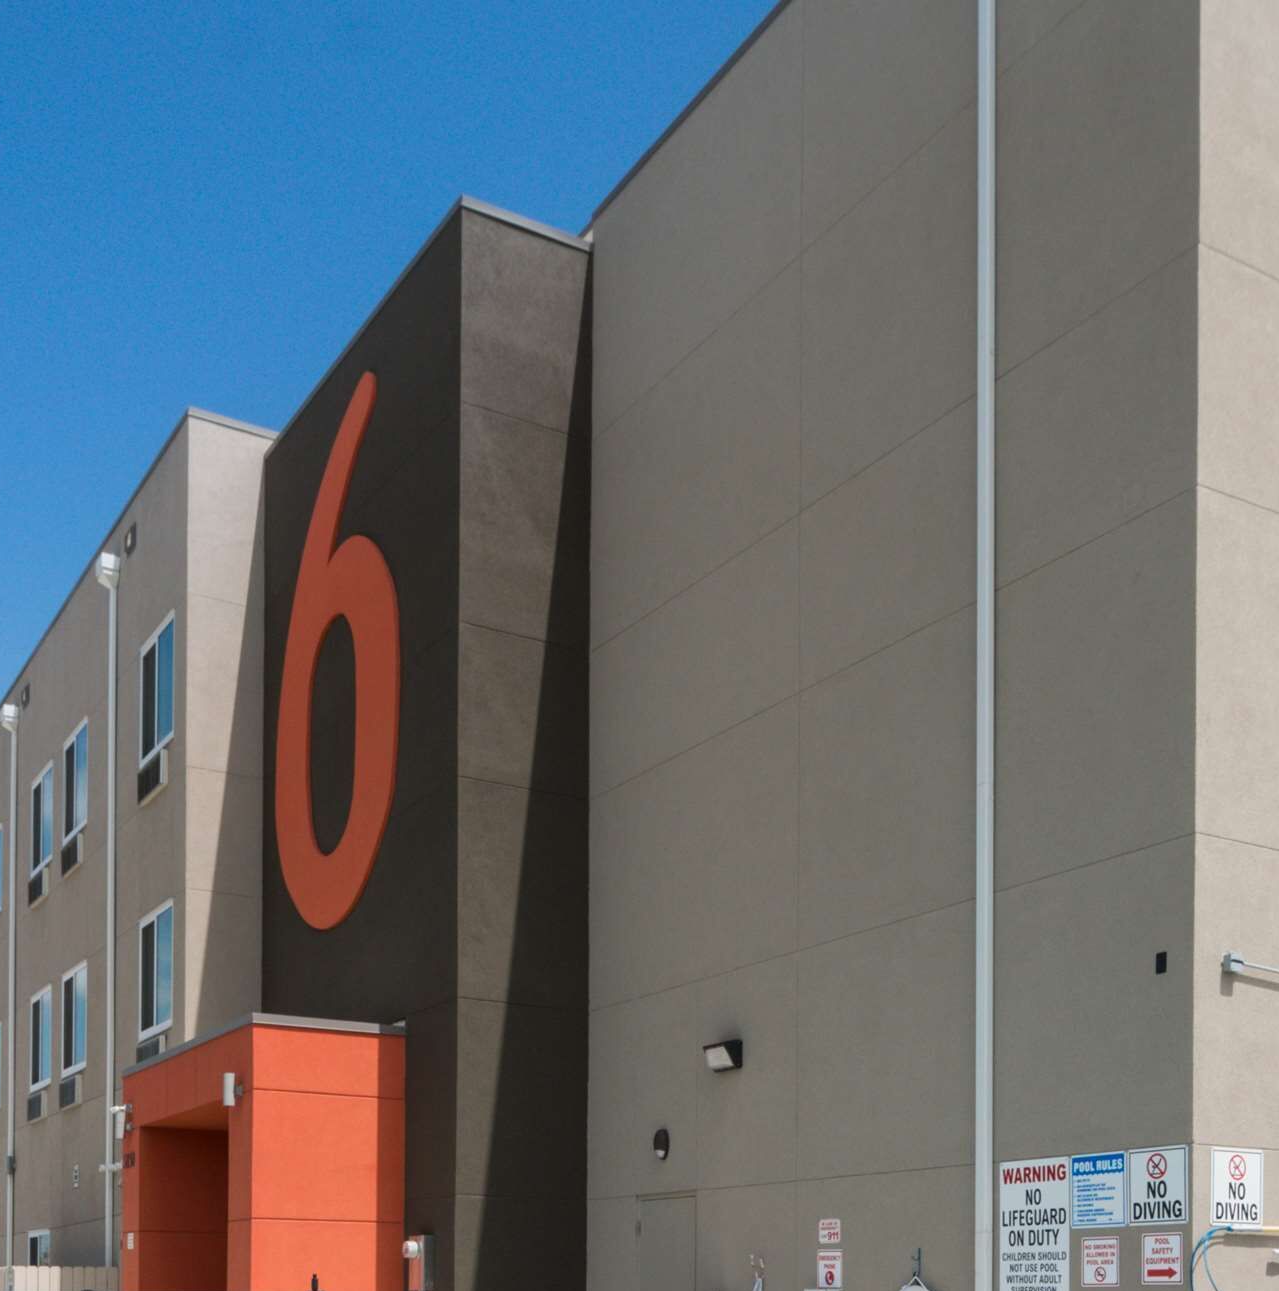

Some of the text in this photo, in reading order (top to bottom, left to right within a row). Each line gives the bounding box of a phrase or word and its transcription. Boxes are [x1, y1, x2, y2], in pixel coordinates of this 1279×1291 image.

[275, 371, 400, 930] 6
[1002, 1163, 1067, 1185] WARNING
[1073, 1158, 1123, 1173] POOL RULES
[1025, 1188, 1042, 1206] NO
[1146, 1180, 1168, 1199] NO
[1228, 1182, 1246, 1200] NO
[1002, 1207, 1067, 1227] LIFEGUARD
[1133, 1199, 1183, 1220] DIVING
[1215, 1201, 1258, 1221] DIVING
[827, 1231, 840, 1241] 911
[1008, 1228, 1060, 1247] ON DUTY
[1002, 1251, 1067, 1261] CHILDREN SHOULD
[1146, 1257, 1180, 1265] EQUIPMENT
[1009, 1263, 1058, 1272] NOT USE POOL
[1006, 1274, 1062, 1284] WITHOUT ADULT
